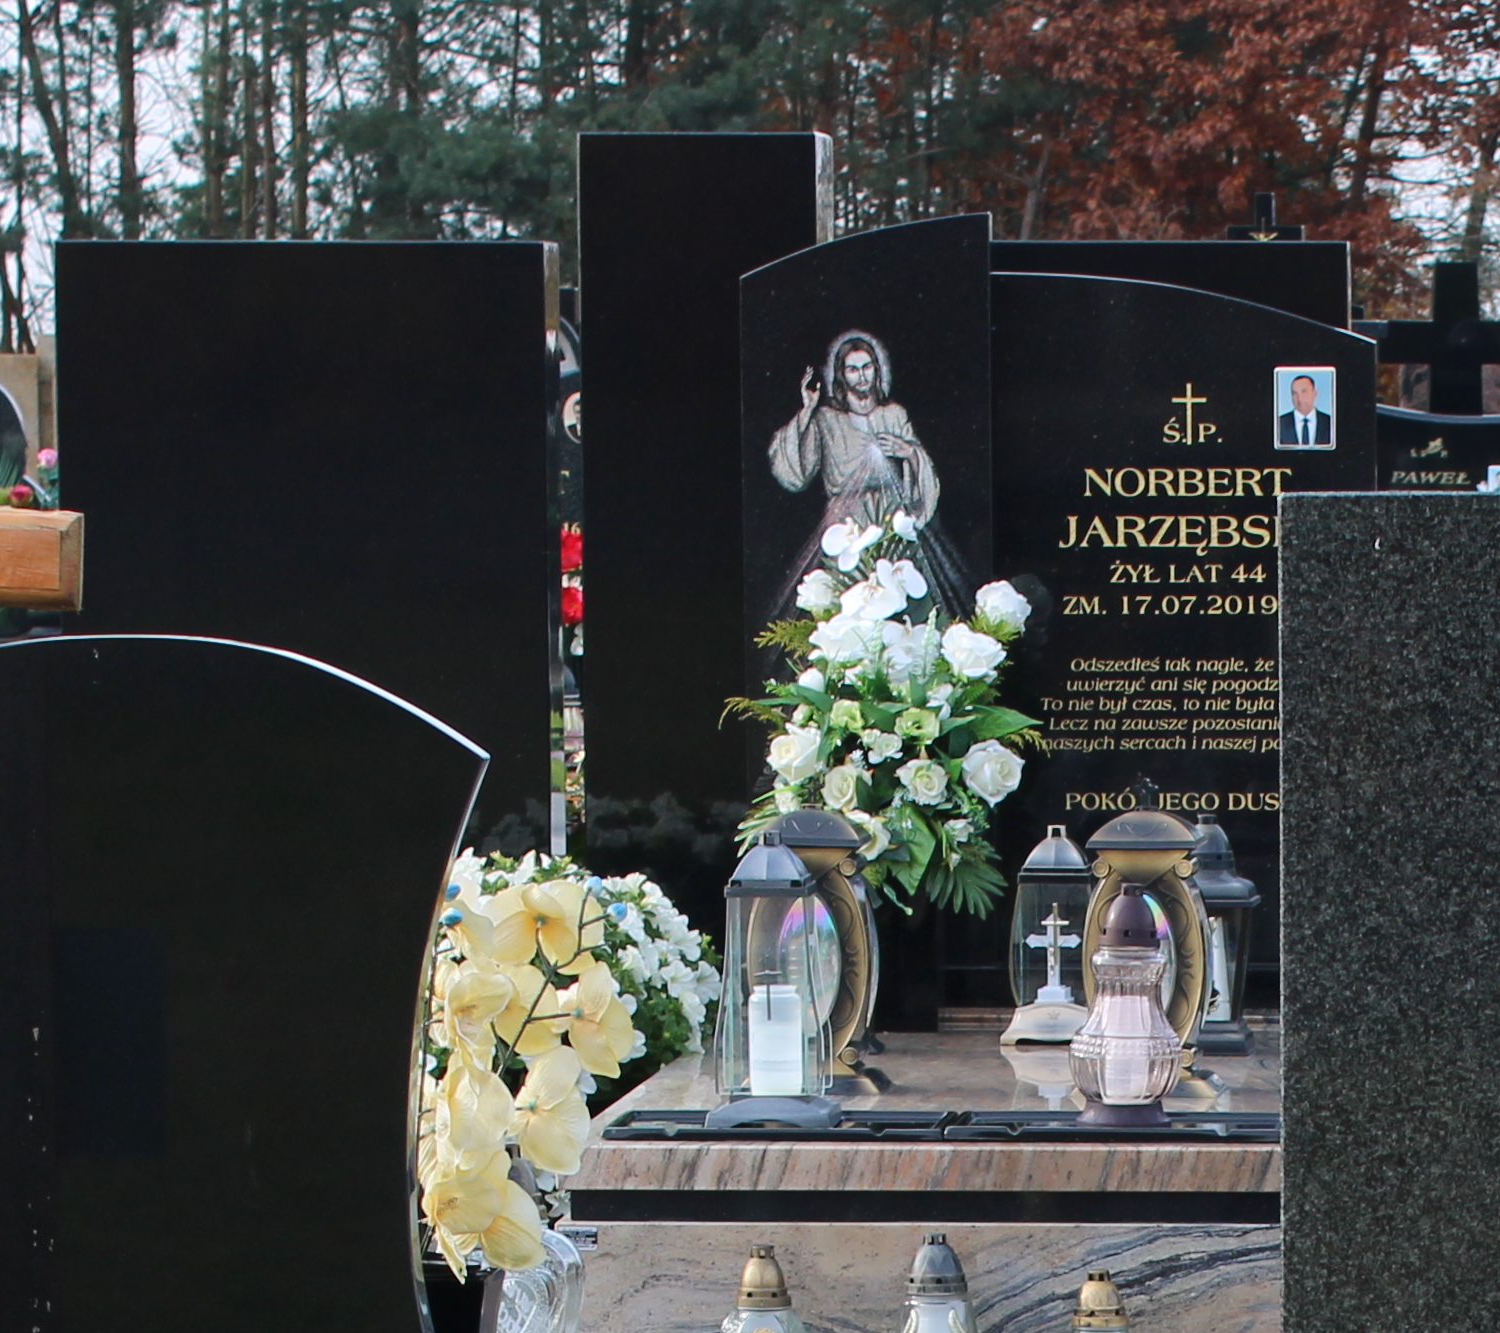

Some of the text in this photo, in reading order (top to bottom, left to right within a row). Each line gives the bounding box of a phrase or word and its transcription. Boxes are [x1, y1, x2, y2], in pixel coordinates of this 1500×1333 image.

[1198, 422, 1223, 443] P.
[1083, 467, 1292, 498] NORBERT
[1390, 471, 1471, 484] PAWEŁ
[1109, 560, 1267, 583] ŻYŁ LAT 44
[1062, 595, 1107, 615] ZM.
[1070, 657, 1160, 672] Odszedłeś
[1165, 657, 1191, 672] tak
[1254, 657, 1275, 673] że
[1066, 676, 1146, 694] uwierzyć
[1151, 677, 1179, 692] ani
[1182, 677, 1207, 694] się
[1040, 697, 1063, 711] To
[1068, 696, 1094, 711] nie
[1099, 696, 1128, 714] był
[1183, 697, 1199, 711] to
[1204, 696, 1230, 711] nie
[1235, 696, 1275, 714] była
[1049, 716, 1088, 731] Lecz
[1093, 718, 1116, 731] na
[1121, 718, 1188, 731] zawsze
[1119, 735, 1187, 751] sercach
[1201, 735, 1258, 753] naszej
[1065, 787, 1137, 811] POKÓ
[1158, 791, 1220, 811] JEGO
